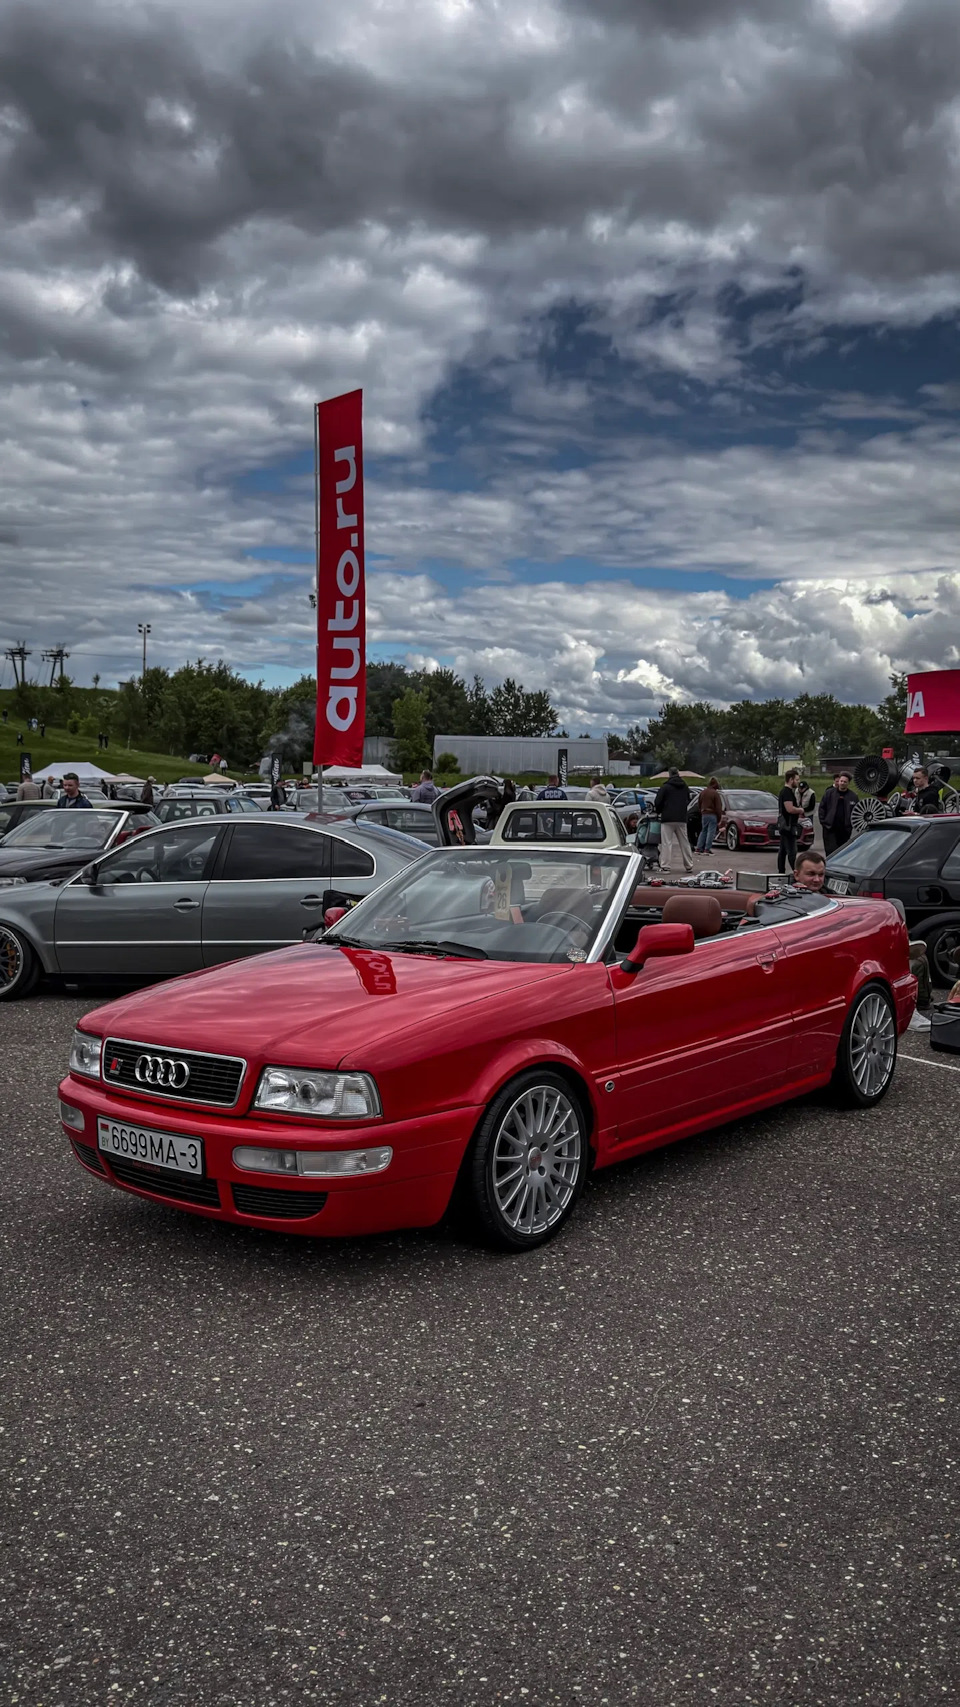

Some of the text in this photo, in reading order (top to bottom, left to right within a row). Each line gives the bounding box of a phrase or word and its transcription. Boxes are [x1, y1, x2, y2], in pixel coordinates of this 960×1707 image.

[326, 445, 361, 732] auto.ru
[101, 1136, 109, 1147] BY
[111, 1126, 198, 1169] 6699MA-3
